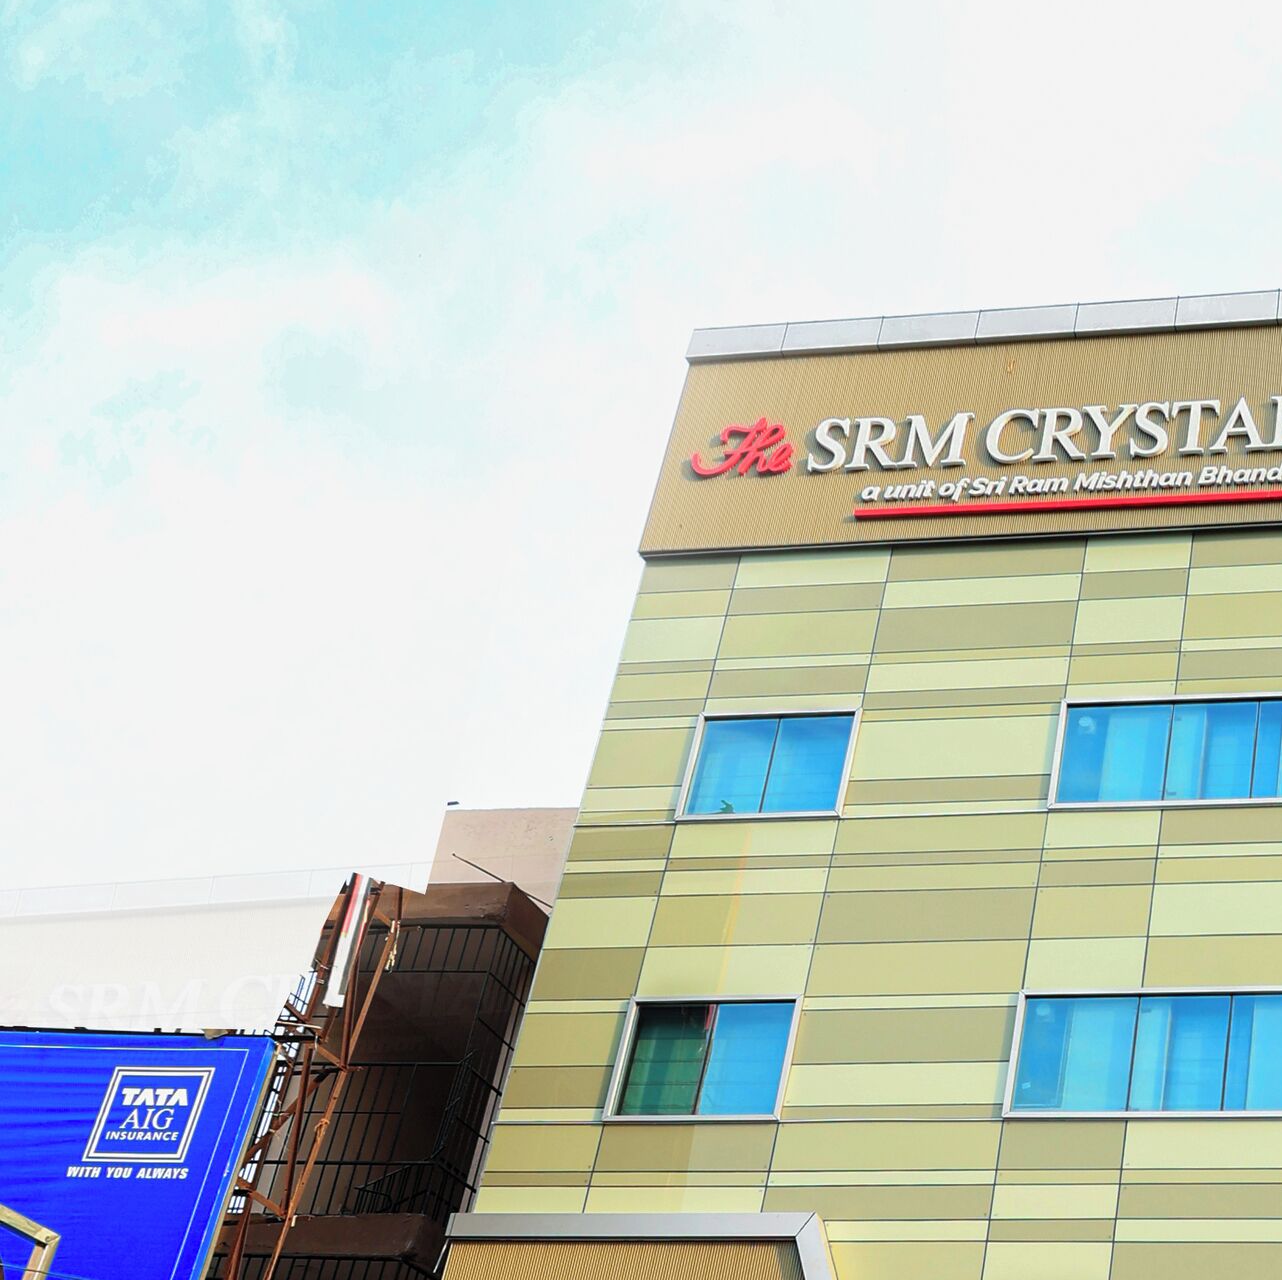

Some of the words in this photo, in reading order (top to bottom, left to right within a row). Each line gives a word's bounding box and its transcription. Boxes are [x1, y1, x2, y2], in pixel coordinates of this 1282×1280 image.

[692, 417, 795, 477] The
[807, 412, 975, 473] SRM
[861, 485, 878, 502] a
[883, 479, 936, 500] unit
[938, 476, 969, 503] of
[969, 474, 1003, 498] Sri
[1009, 472, 1069, 495] Ram
[1073, 467, 1194, 493] Mishthan
[122, 1088, 188, 1106] TATA
[119, 1108, 174, 1130] AIG
[105, 1131, 179, 1141] INSURANCE
[66, 1166, 102, 1178] WITH
[106, 1167, 132, 1179] YOU
[136, 1168, 189, 1179] ALWAYS
